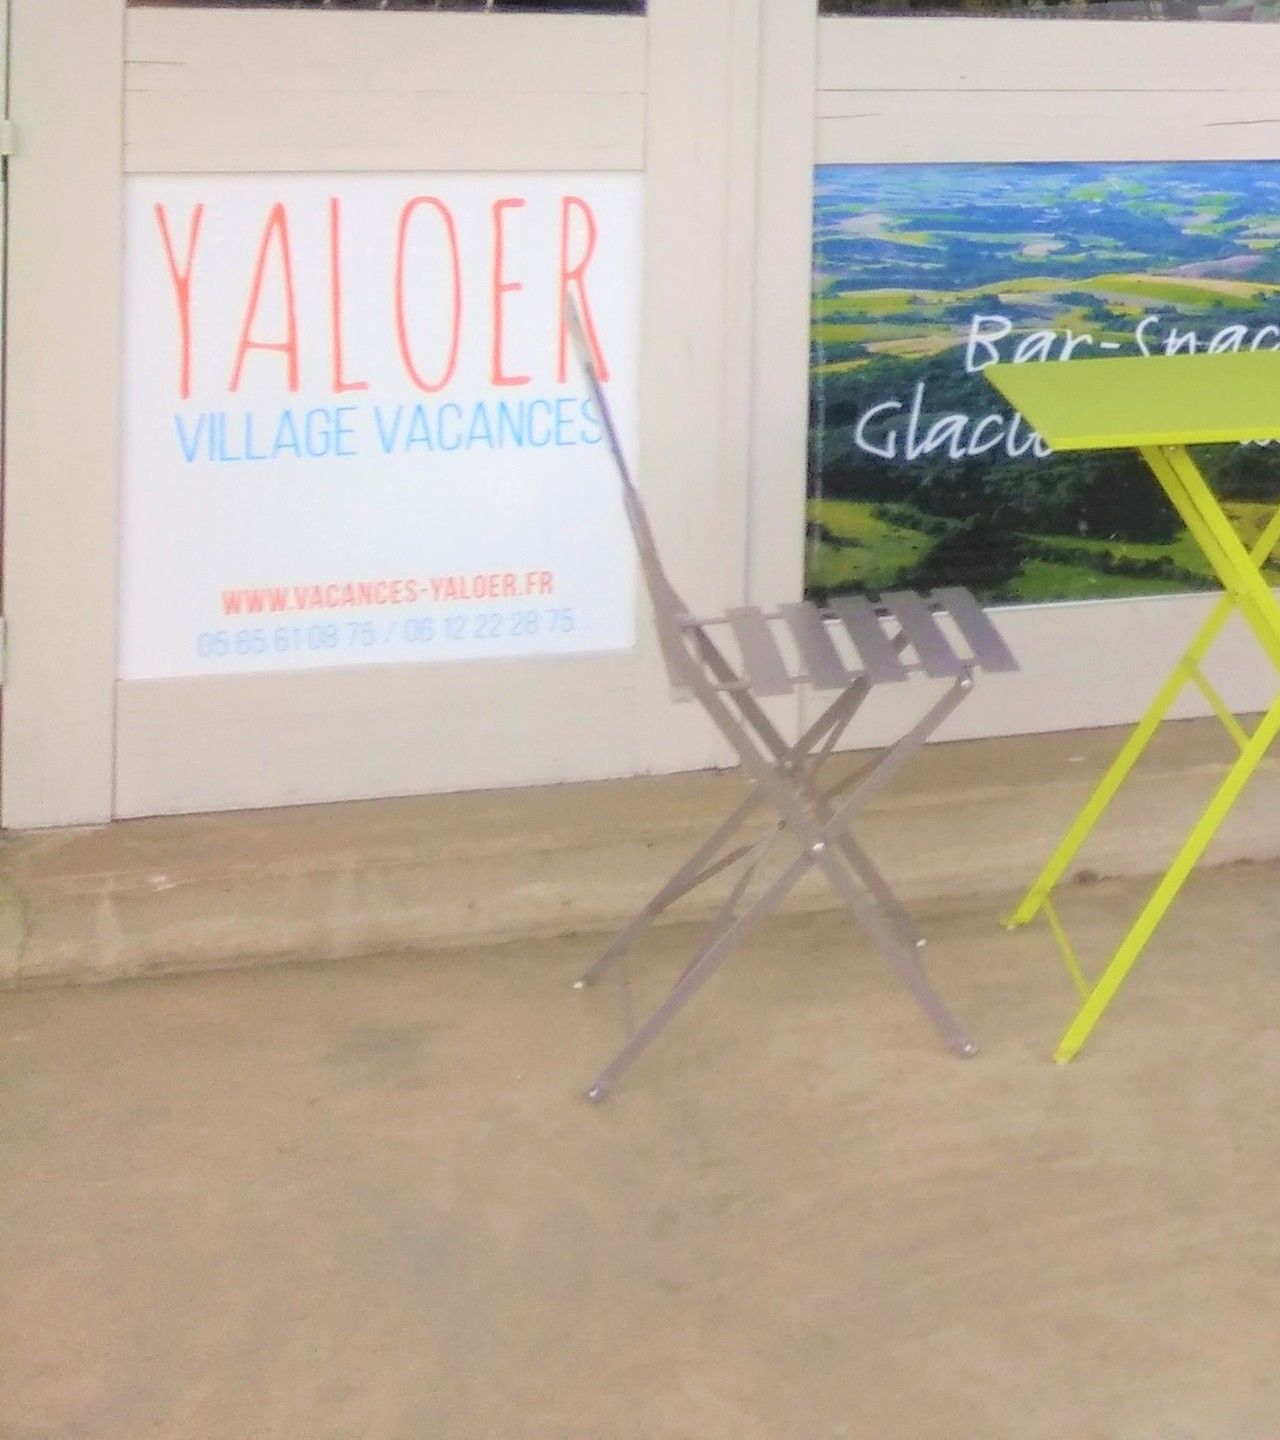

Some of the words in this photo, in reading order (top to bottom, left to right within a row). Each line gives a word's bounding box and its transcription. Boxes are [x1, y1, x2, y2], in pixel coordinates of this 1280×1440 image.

[154, 195, 610, 399] YALOER
[175, 406, 358, 463] VILLAGE
[374, 398, 605, 454] VACANCES
[222, 570, 554, 615] WWW.VACANCES-YALOER.FR
